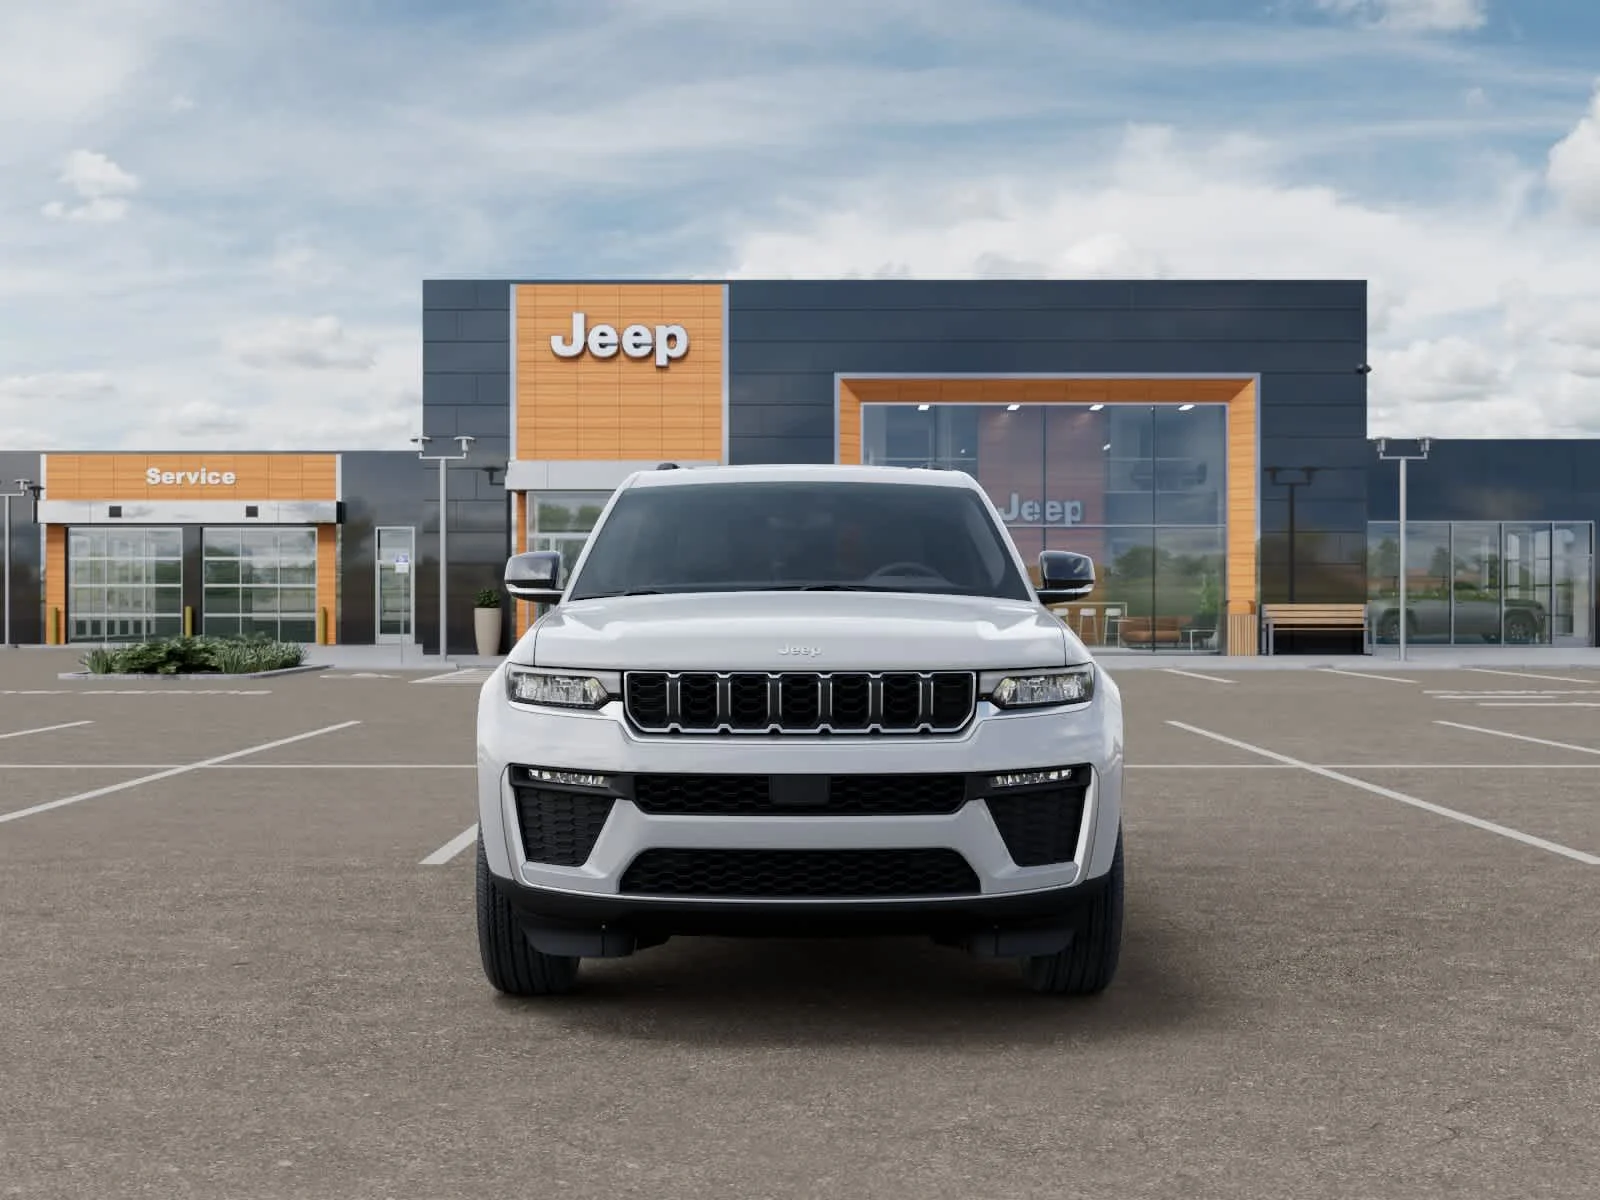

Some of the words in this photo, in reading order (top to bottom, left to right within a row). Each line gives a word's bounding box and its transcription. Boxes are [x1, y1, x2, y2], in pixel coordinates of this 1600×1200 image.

[550, 311, 689, 368] Jeep
[146, 466, 236, 485] Service
[998, 492, 1083, 526] Jeep
[777, 642, 822, 658] Jeep
